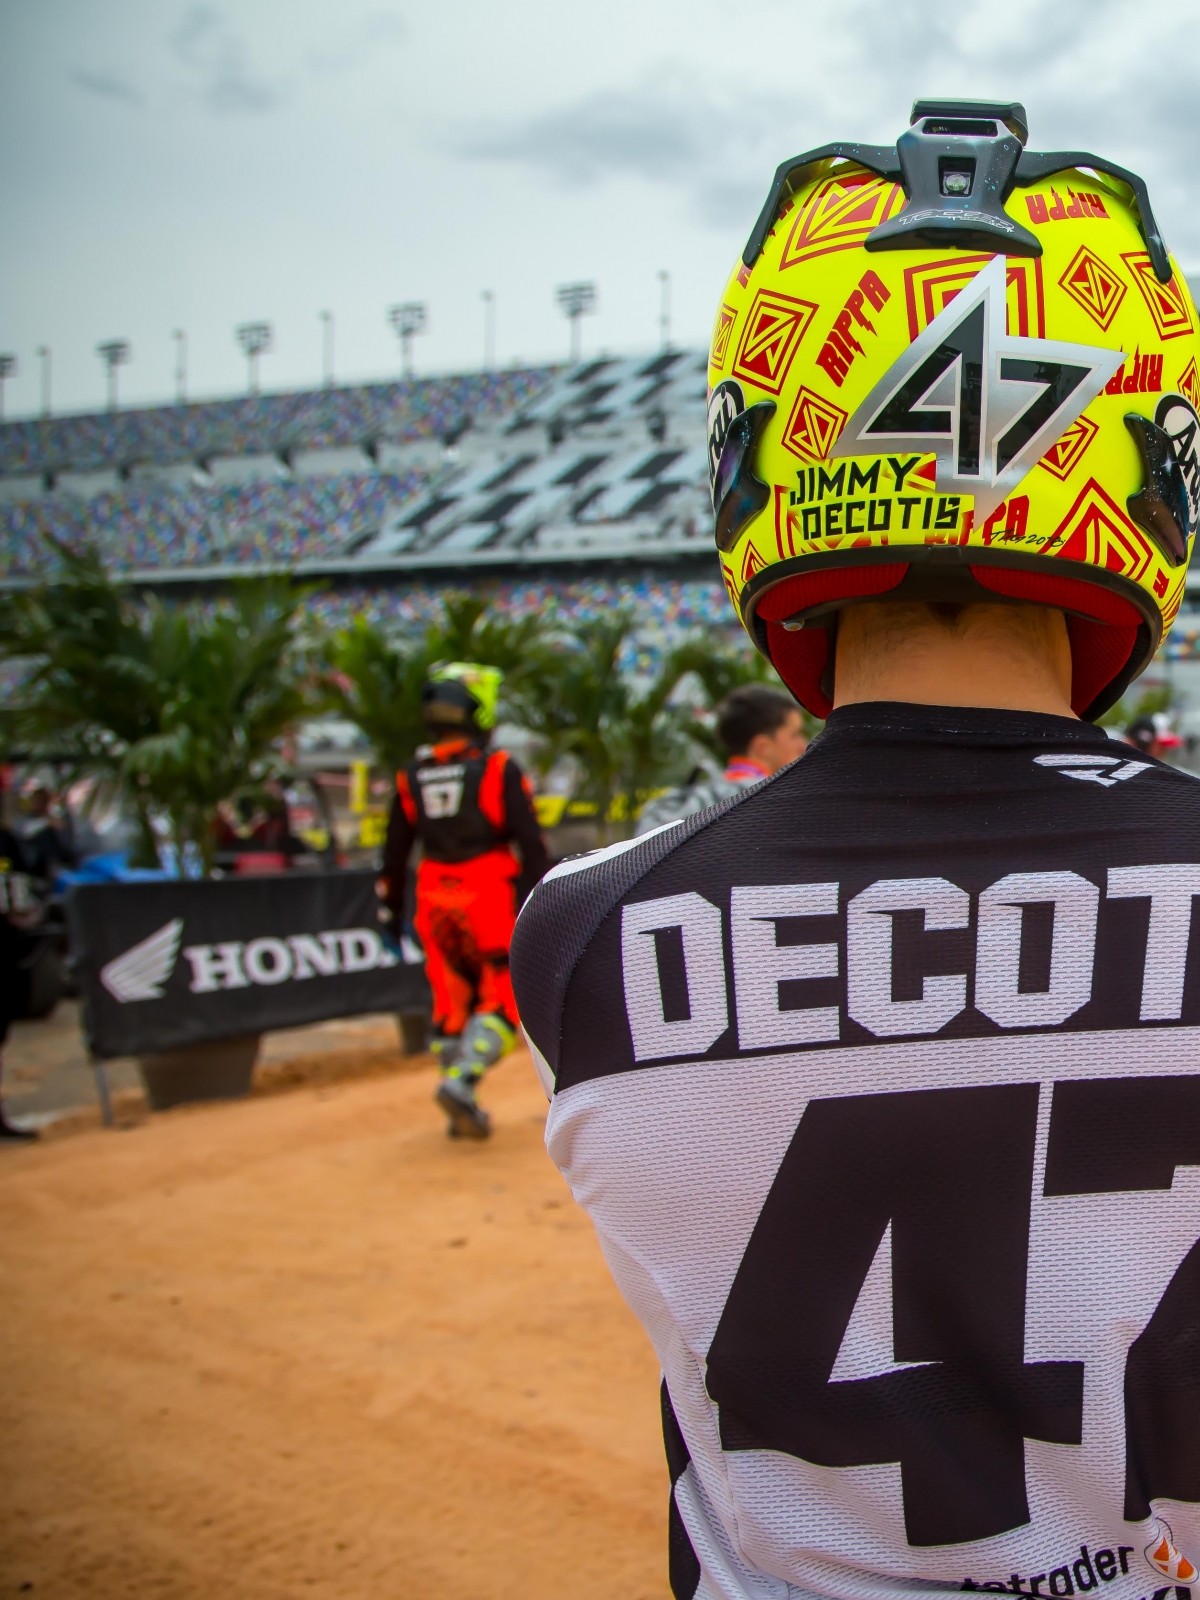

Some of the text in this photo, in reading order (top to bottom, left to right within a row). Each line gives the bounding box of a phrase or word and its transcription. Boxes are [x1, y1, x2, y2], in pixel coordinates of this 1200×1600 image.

[1025, 185, 1110, 224] RIPPA
[816, 270, 891, 387] RIPPA
[857, 290, 1103, 488] 47
[1098, 343, 1163, 396] RIPP
[790, 457, 921, 506] JIMMY
[801, 497, 960, 540] DECOTIS
